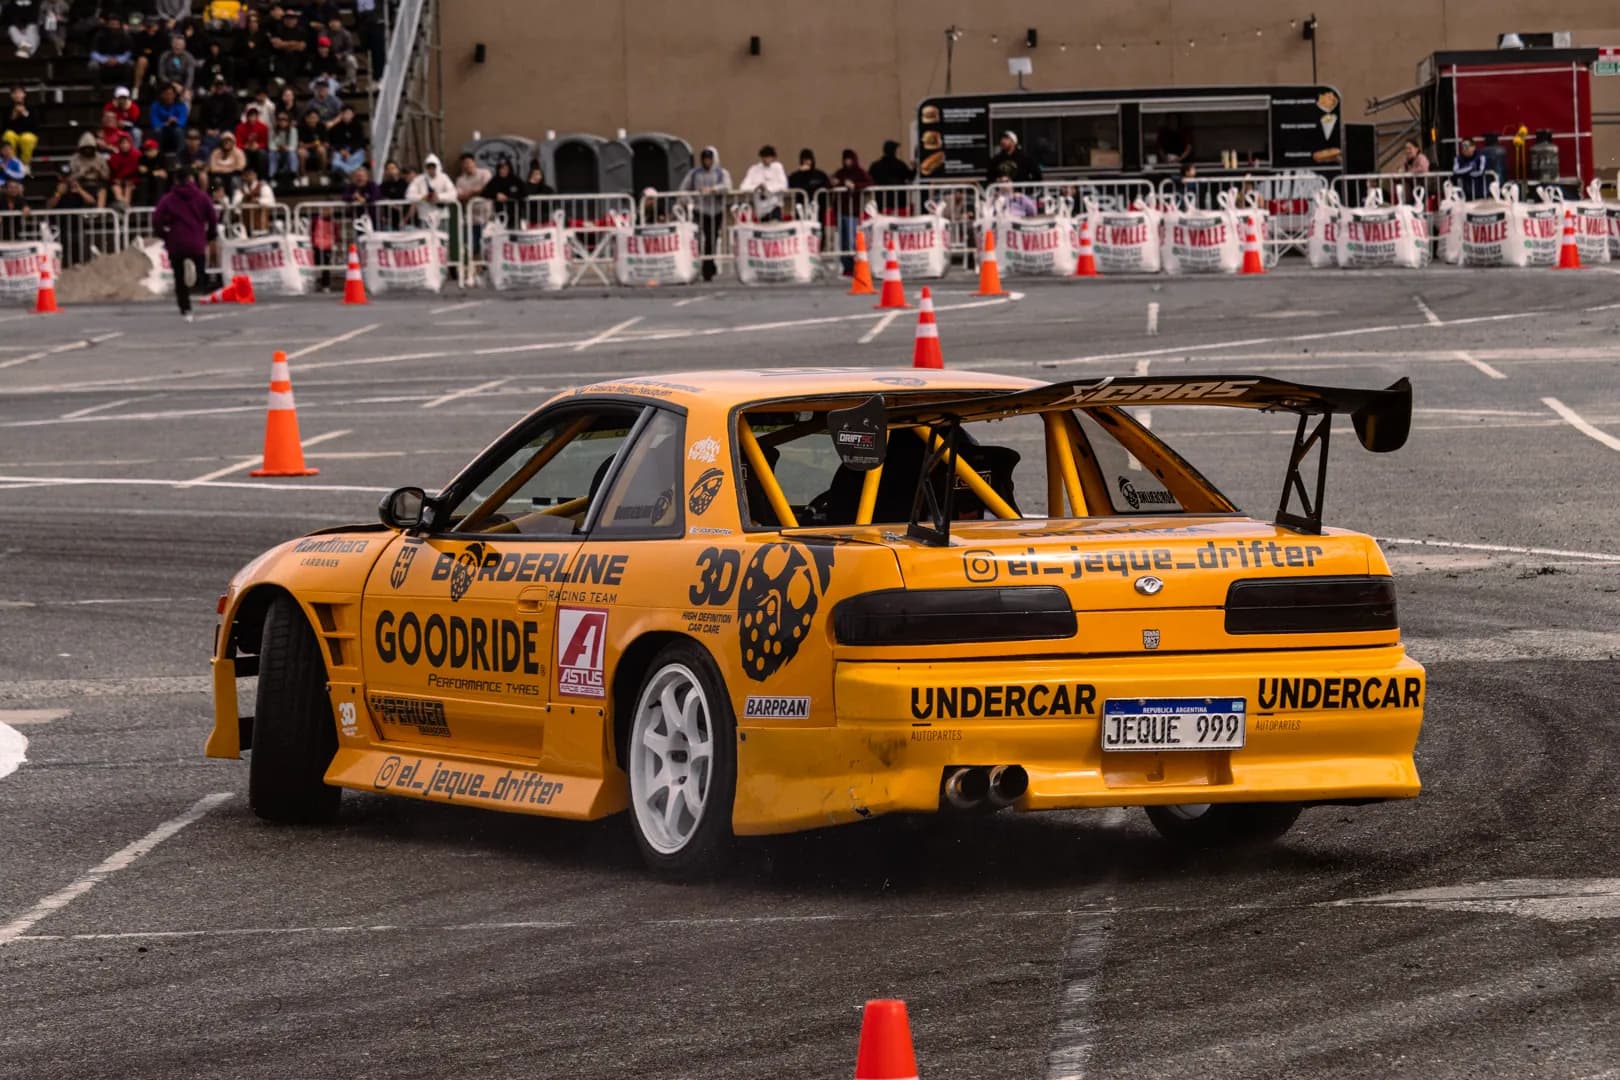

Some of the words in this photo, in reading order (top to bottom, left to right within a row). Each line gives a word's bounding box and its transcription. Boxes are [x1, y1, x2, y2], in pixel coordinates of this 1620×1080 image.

[899, 229, 935, 251] VALLE
[1006, 230, 1019, 250] EL
[1022, 229, 1058, 251] VALLE
[1096, 224, 1107, 244] EL
[1111, 224, 1147, 246] VALLE
[1174, 225, 1185, 245] EL
[1188, 224, 1226, 247] VALLE
[1347, 222, 1360, 241] EL
[1363, 220, 1401, 242] VALLE
[1472, 220, 1508, 244] VALLE
[503, 242, 515, 262] EL
[518, 240, 555, 262] VALLE
[643, 233, 679, 255] VALLE
[762, 236, 800, 258] VALLE
[247, 248, 285, 271] VALLE
[393, 245, 430, 269] VALLE
[1008, 540, 1323, 579] el_jeque_drifter
[689, 546, 741, 606] 3D
[548, 590, 586, 602] RACING
[590, 592, 618, 605] TEAM
[699, 613, 733, 624] DEFINITION
[375, 609, 540, 675] GOODRIDE
[560, 669, 603, 685] ASTUS
[507, 683, 539, 696] TYRES
[1257, 677, 1421, 710] UNDERCAR
[746, 699, 809, 716] BARPRAN
[911, 684, 1097, 720] UNDERCAR
[1175, 706, 1208, 714] ARGENTINA
[911, 729, 962, 742] AUTOPARTES
[1107, 716, 1181, 744] JEQUE
[1197, 715, 1239, 743] 999
[1256, 719, 1301, 731] AUTOPARTES
[396, 759, 564, 805] el_jeque_drifter
